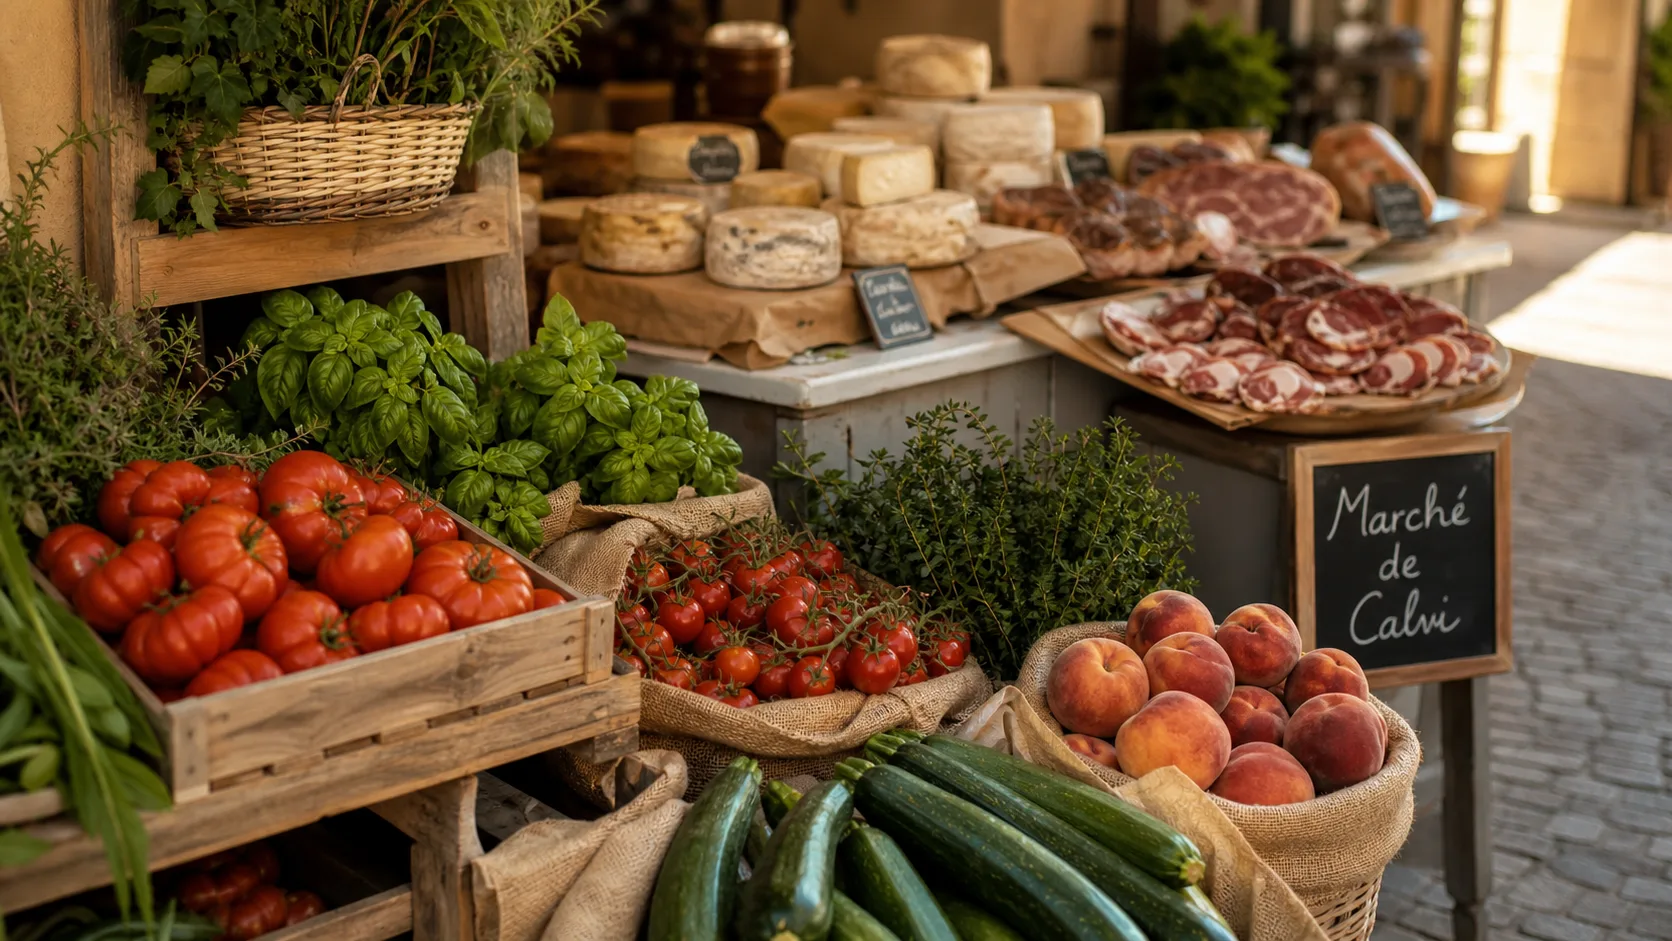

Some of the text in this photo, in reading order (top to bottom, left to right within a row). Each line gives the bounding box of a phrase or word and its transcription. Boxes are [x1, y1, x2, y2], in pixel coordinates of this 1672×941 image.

[1327, 483, 1470, 541] Marché
[1379, 542, 1420, 581] de
[1350, 588, 1461, 645] Calvi
